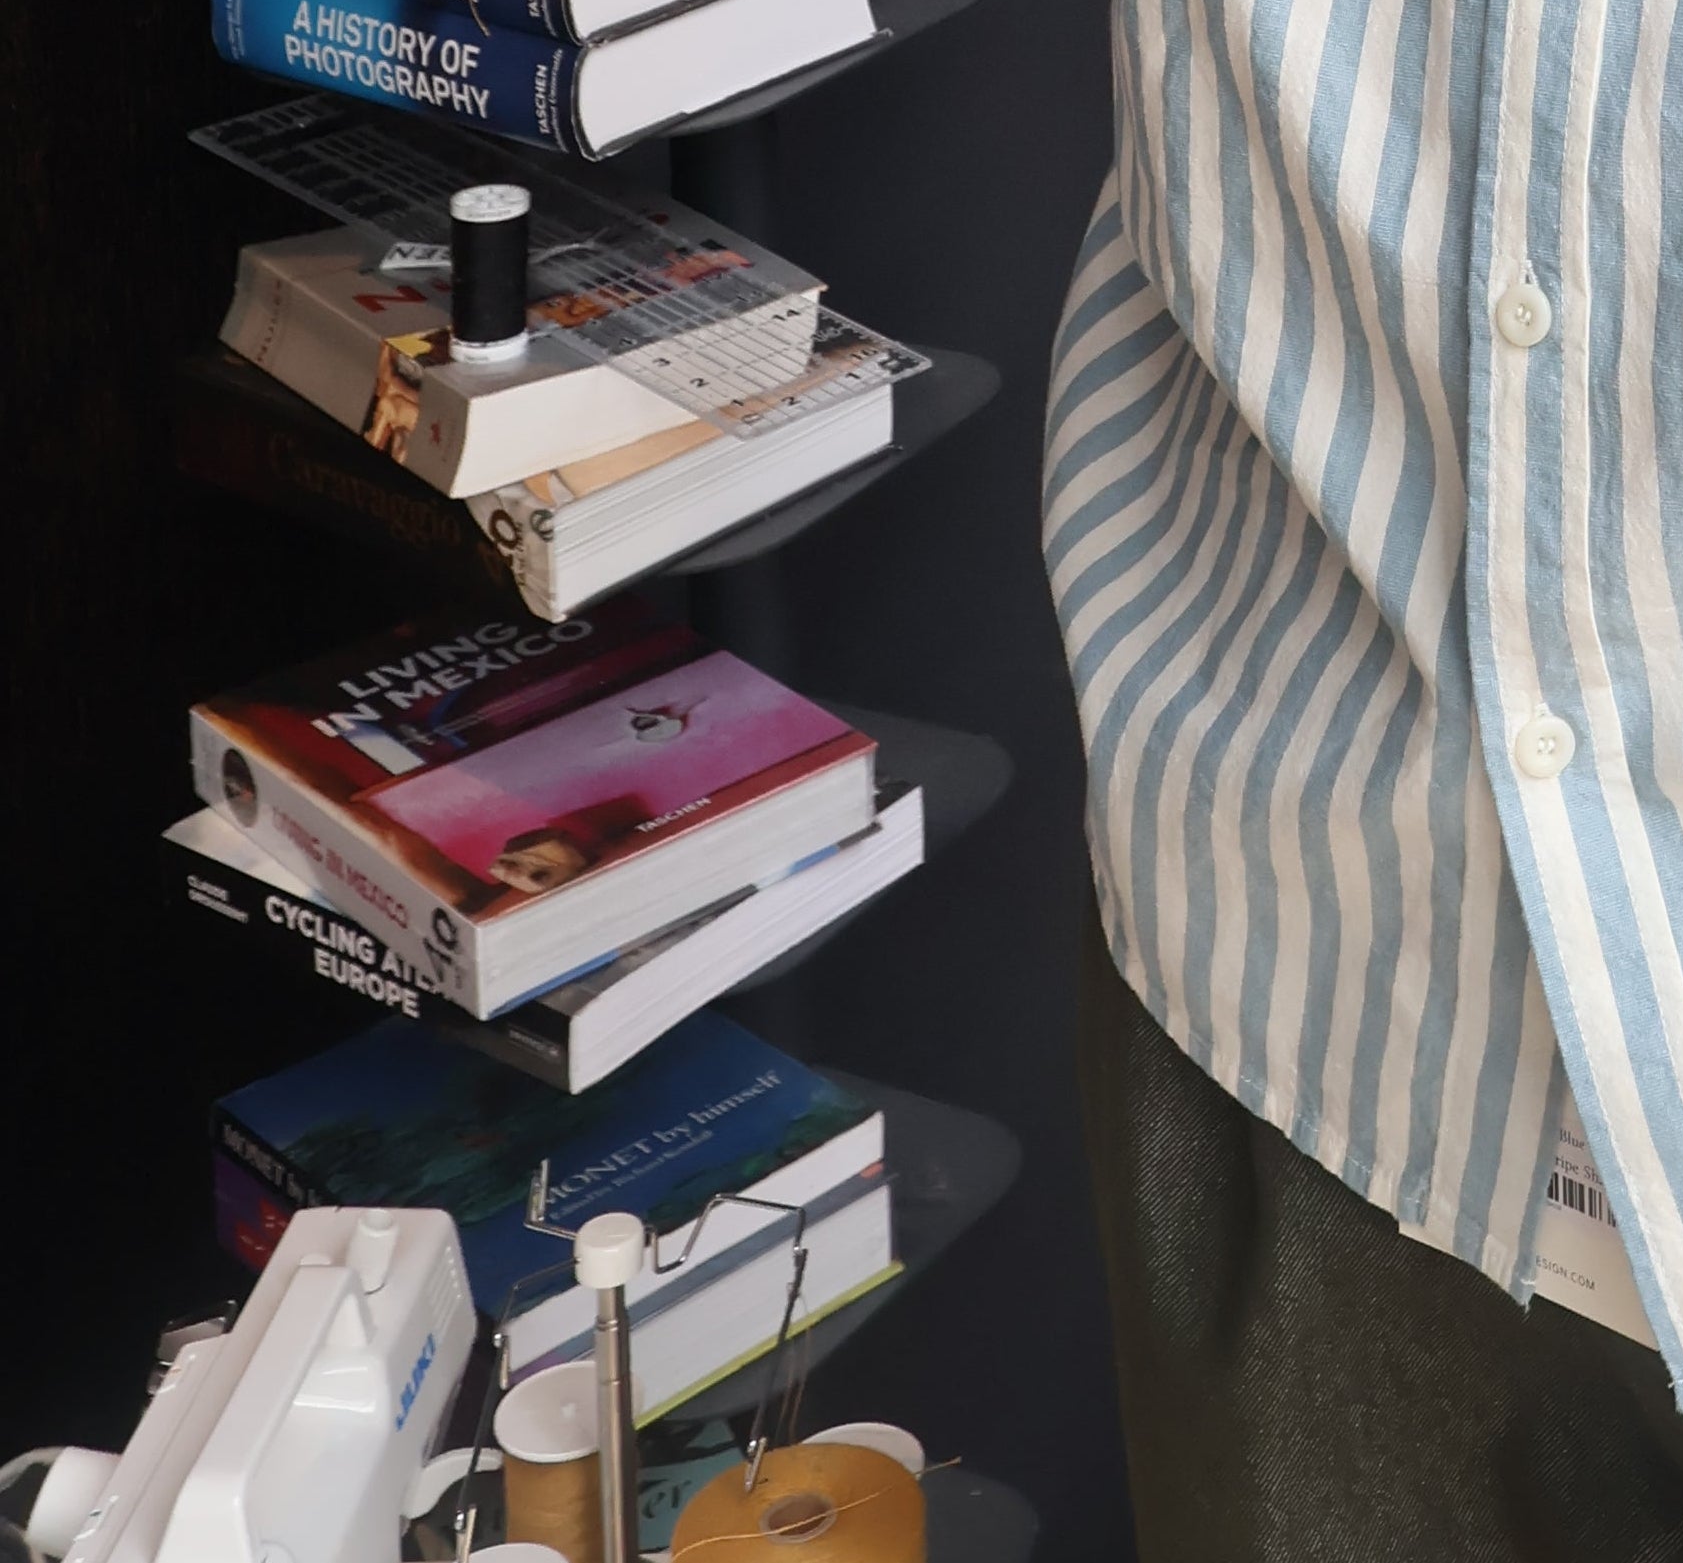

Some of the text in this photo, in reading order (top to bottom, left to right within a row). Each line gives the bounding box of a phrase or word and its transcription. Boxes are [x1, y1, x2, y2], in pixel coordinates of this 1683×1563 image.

[292, 0, 481, 78] A HISTORY OF
[283, 34, 490, 120] PHOTOGRAPHY
[534, 64, 551, 135] TASCHEN
[772, 309, 801, 321] 14
[690, 377, 710, 387] 2
[731, 398, 744, 407] 1
[781, 371, 861, 407] 2 1
[269, 432, 461, 544] Caravaggio
[310, 701, 383, 738] IN
[384, 620, 594, 710] MEXICO
[337, 622, 518, 699] LIVING
[633, 797, 712, 833] TASCHEN
[346, 863, 410, 930] MEXICO
[265, 896, 375, 964] CYCLING
[384, 947, 438, 994] ATL
[314, 948, 422, 1019] EUROPE
[546, 1069, 783, 1204] MONET by himself
[1555, 1157, 1579, 1175] ripe
[1559, 1129, 1585, 1150] Blue
[1535, 1256, 1596, 1291] ESIGN.COM
[395, 1333, 436, 1432] JUKI
